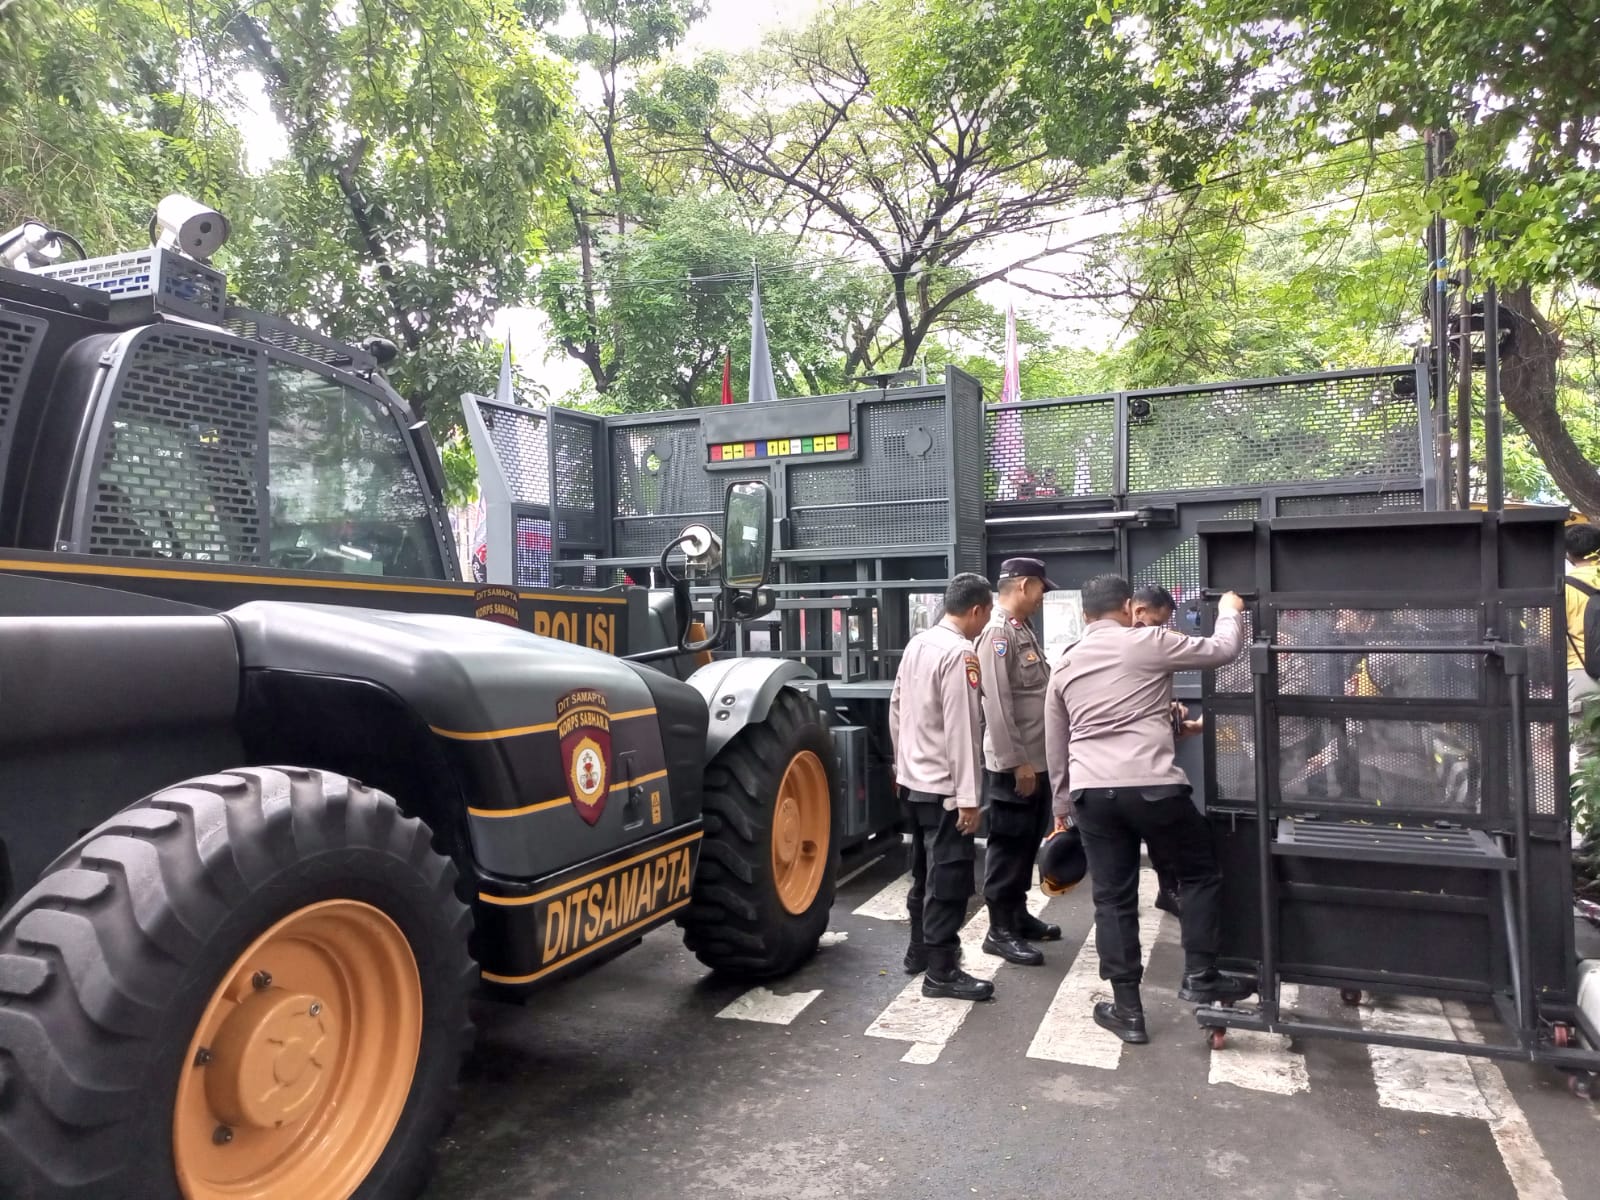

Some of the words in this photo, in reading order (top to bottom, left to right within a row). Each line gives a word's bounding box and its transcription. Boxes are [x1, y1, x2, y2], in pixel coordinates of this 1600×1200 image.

[475, 604, 494, 618] KORPS
[557, 696, 571, 713] DIT
[571, 691, 606, 707] SAMAPTA
[559, 715, 578, 740] KORPS
[579, 712, 610, 733] SABHARA
[542, 848, 690, 964] DITSAMAPTA
